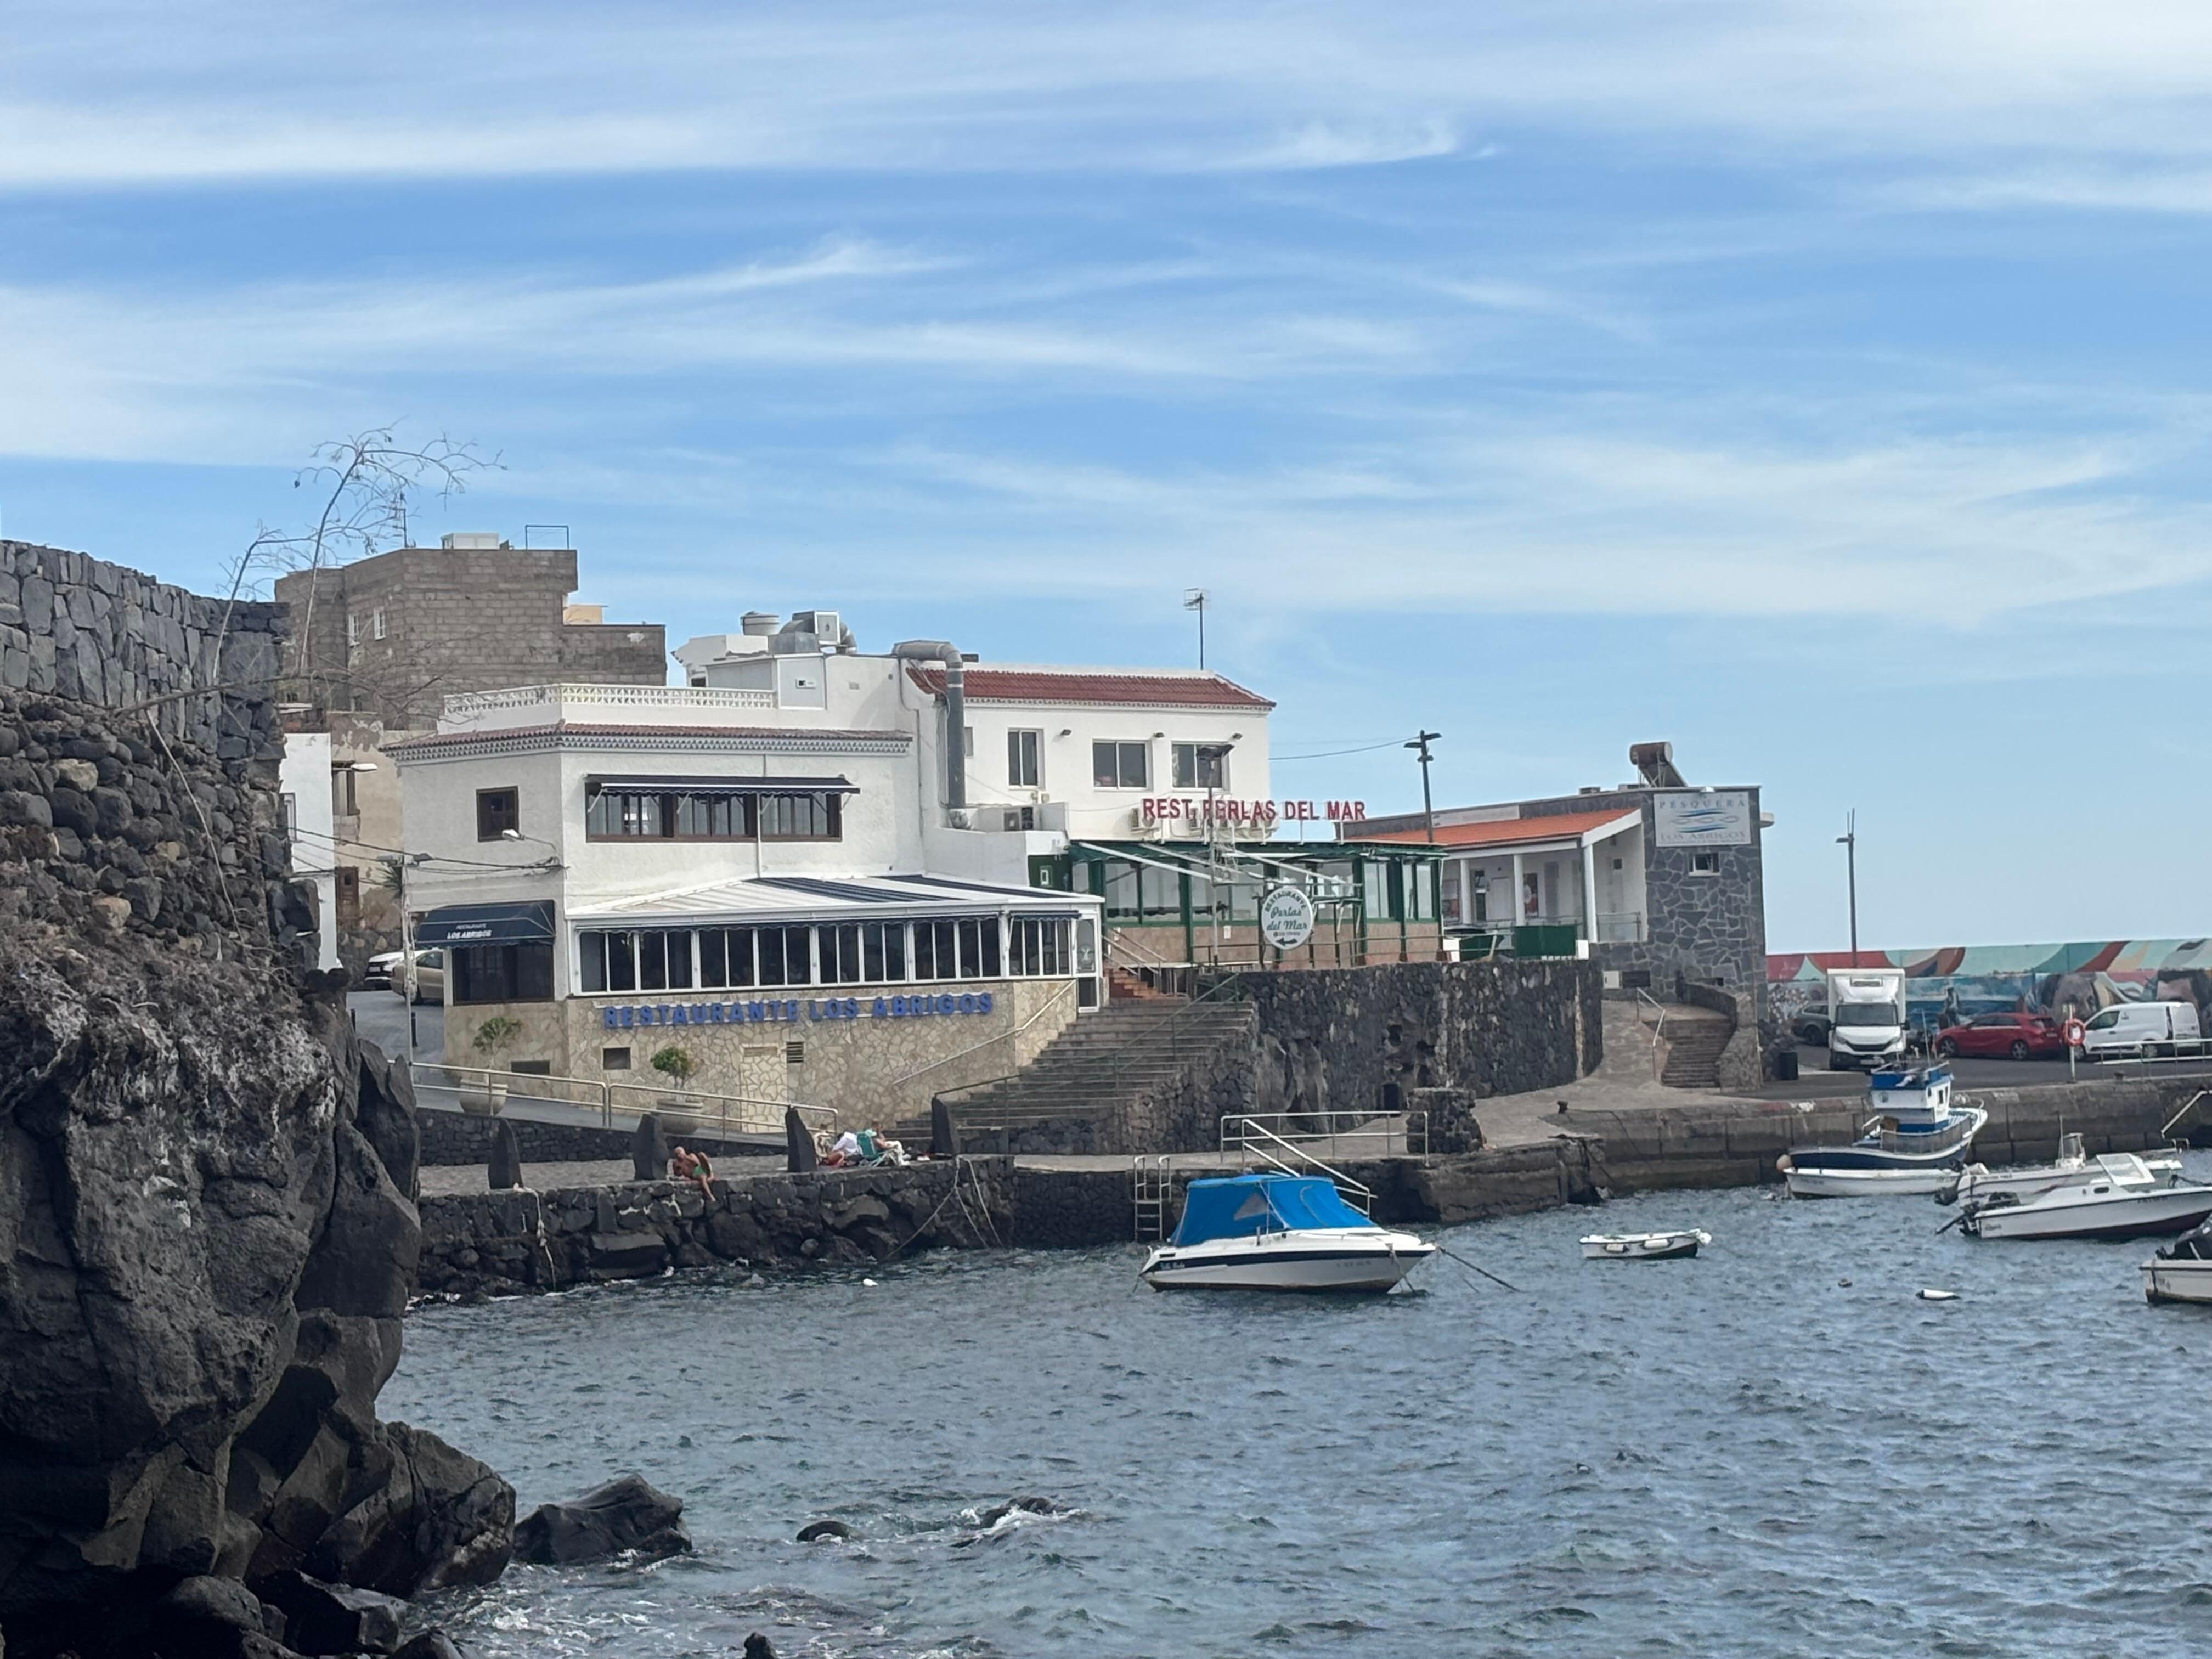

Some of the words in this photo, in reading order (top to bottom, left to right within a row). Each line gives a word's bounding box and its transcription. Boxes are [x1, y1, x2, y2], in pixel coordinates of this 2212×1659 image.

[1659, 799, 1746, 809] PESQUERA
[1202, 800, 1277, 820] PERLAS
[1284, 800, 1320, 820] DEL
[1327, 800, 1366, 821] MAR
[1271, 907, 1301, 919] Perlas
[1267, 921, 1280, 930] del
[1284, 920, 1307, 930] Mar
[605, 1000, 798, 1029] RESTAURANTE
[809, 997, 857, 1021] LOS
[872, 992, 992, 1018] ABRIGOS
